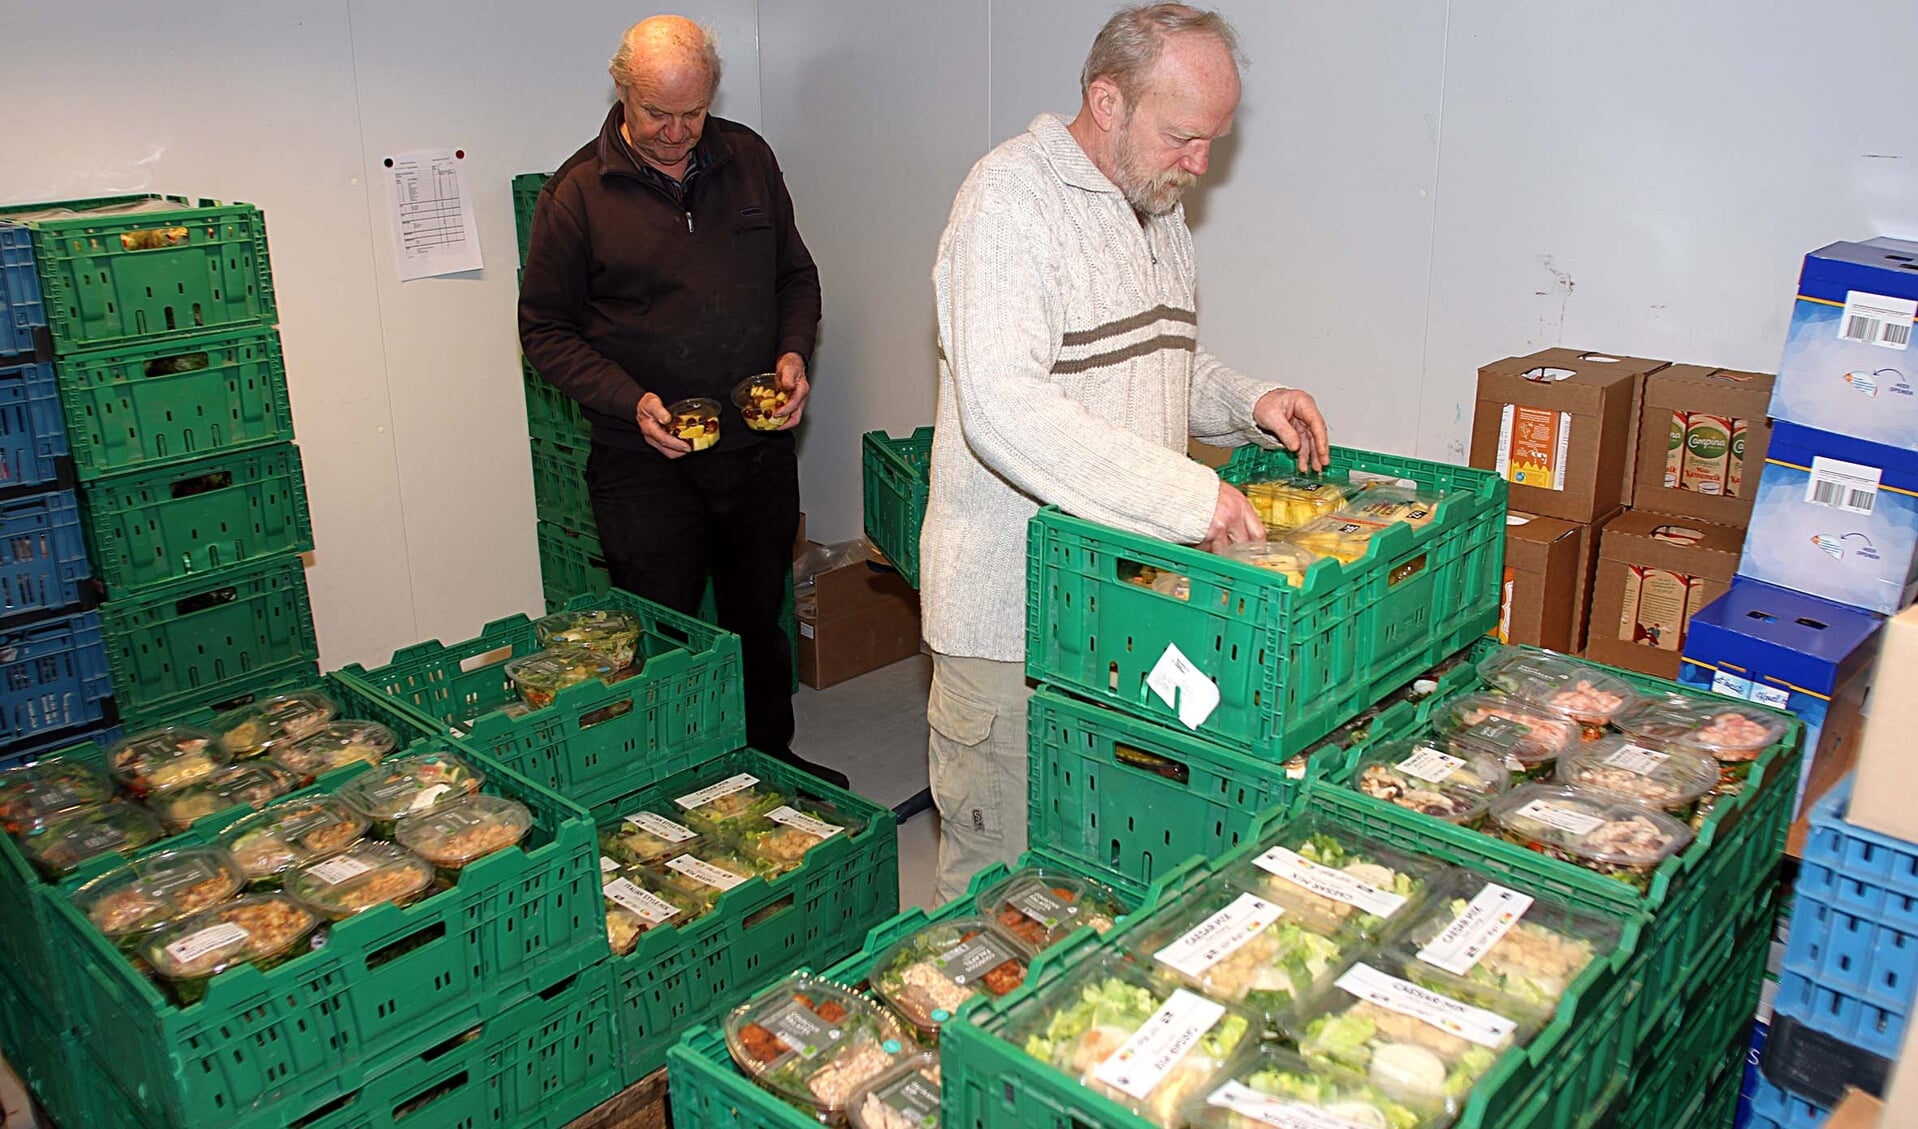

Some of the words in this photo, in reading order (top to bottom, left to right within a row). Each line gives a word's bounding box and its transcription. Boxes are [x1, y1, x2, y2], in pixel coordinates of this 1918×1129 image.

[1688, 434, 1726, 449] Campina
[661, 819, 677, 830] STYLE
[623, 881, 643, 897] ITALIAN
[643, 893, 658, 905] STYLE
[657, 901, 669, 911] MIX
[1213, 910, 1232, 927] MIX
[1462, 903, 1482, 922] MIX
